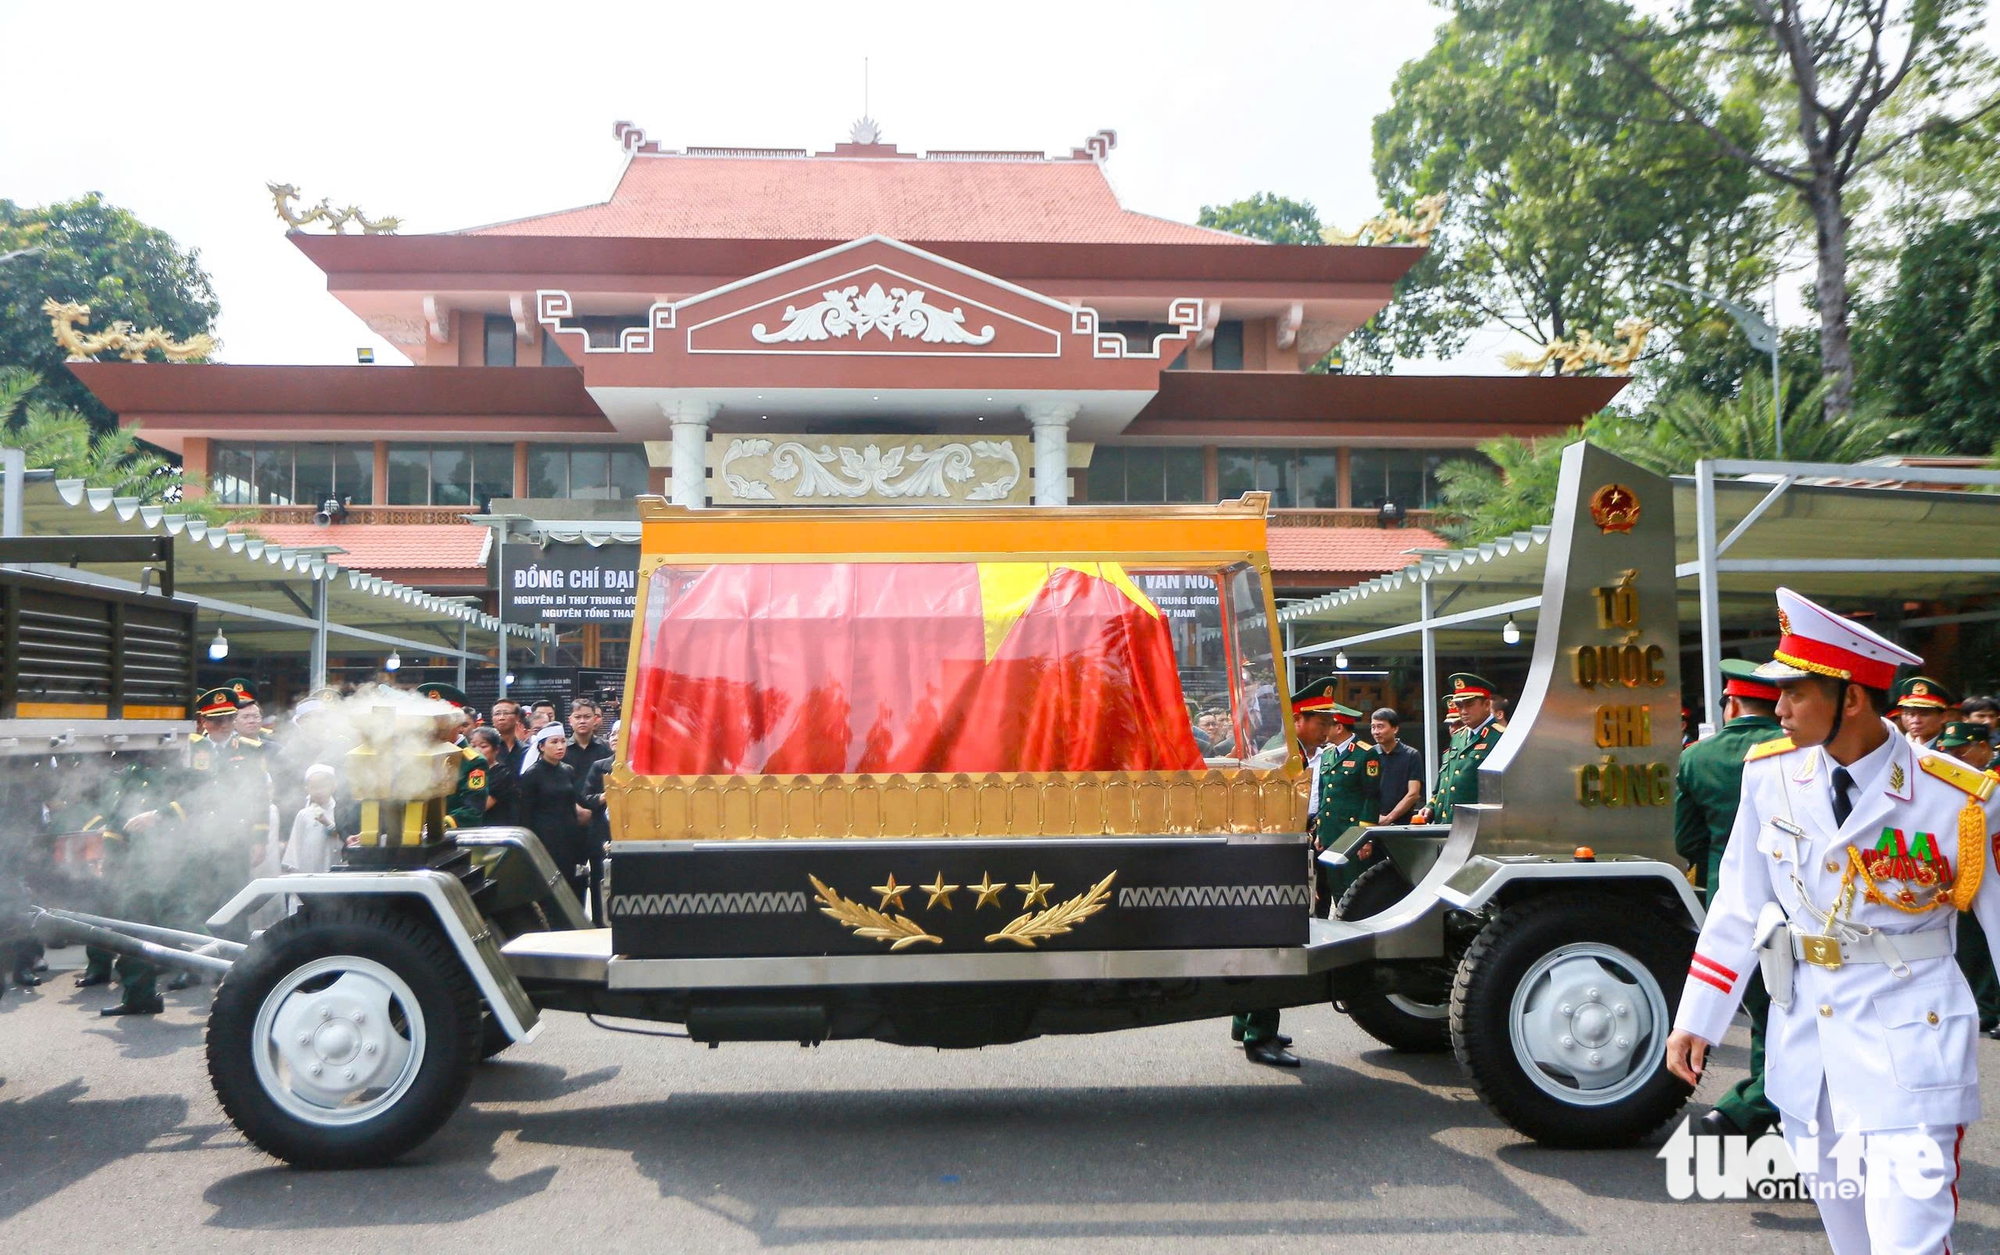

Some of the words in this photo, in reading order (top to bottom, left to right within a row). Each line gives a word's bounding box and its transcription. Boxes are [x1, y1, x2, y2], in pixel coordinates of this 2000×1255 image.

[514, 564, 564, 589] ĐỒNG
[569, 566, 599, 589] CHÍ
[604, 570, 635, 592] ĐẠI
[514, 595, 555, 605] NGUYÊN
[556, 594, 566, 605] BÍ
[568, 596, 589, 605] THƯ
[590, 596, 622, 605] TRUNG
[1156, 596, 1187, 605] TRUNG
[542, 608, 582, 618] NGUYÊN
[1173, 609, 1196, 618] NAM
[1594, 704, 1651, 749] GHI
[1574, 754, 1672, 807] CÔNG
